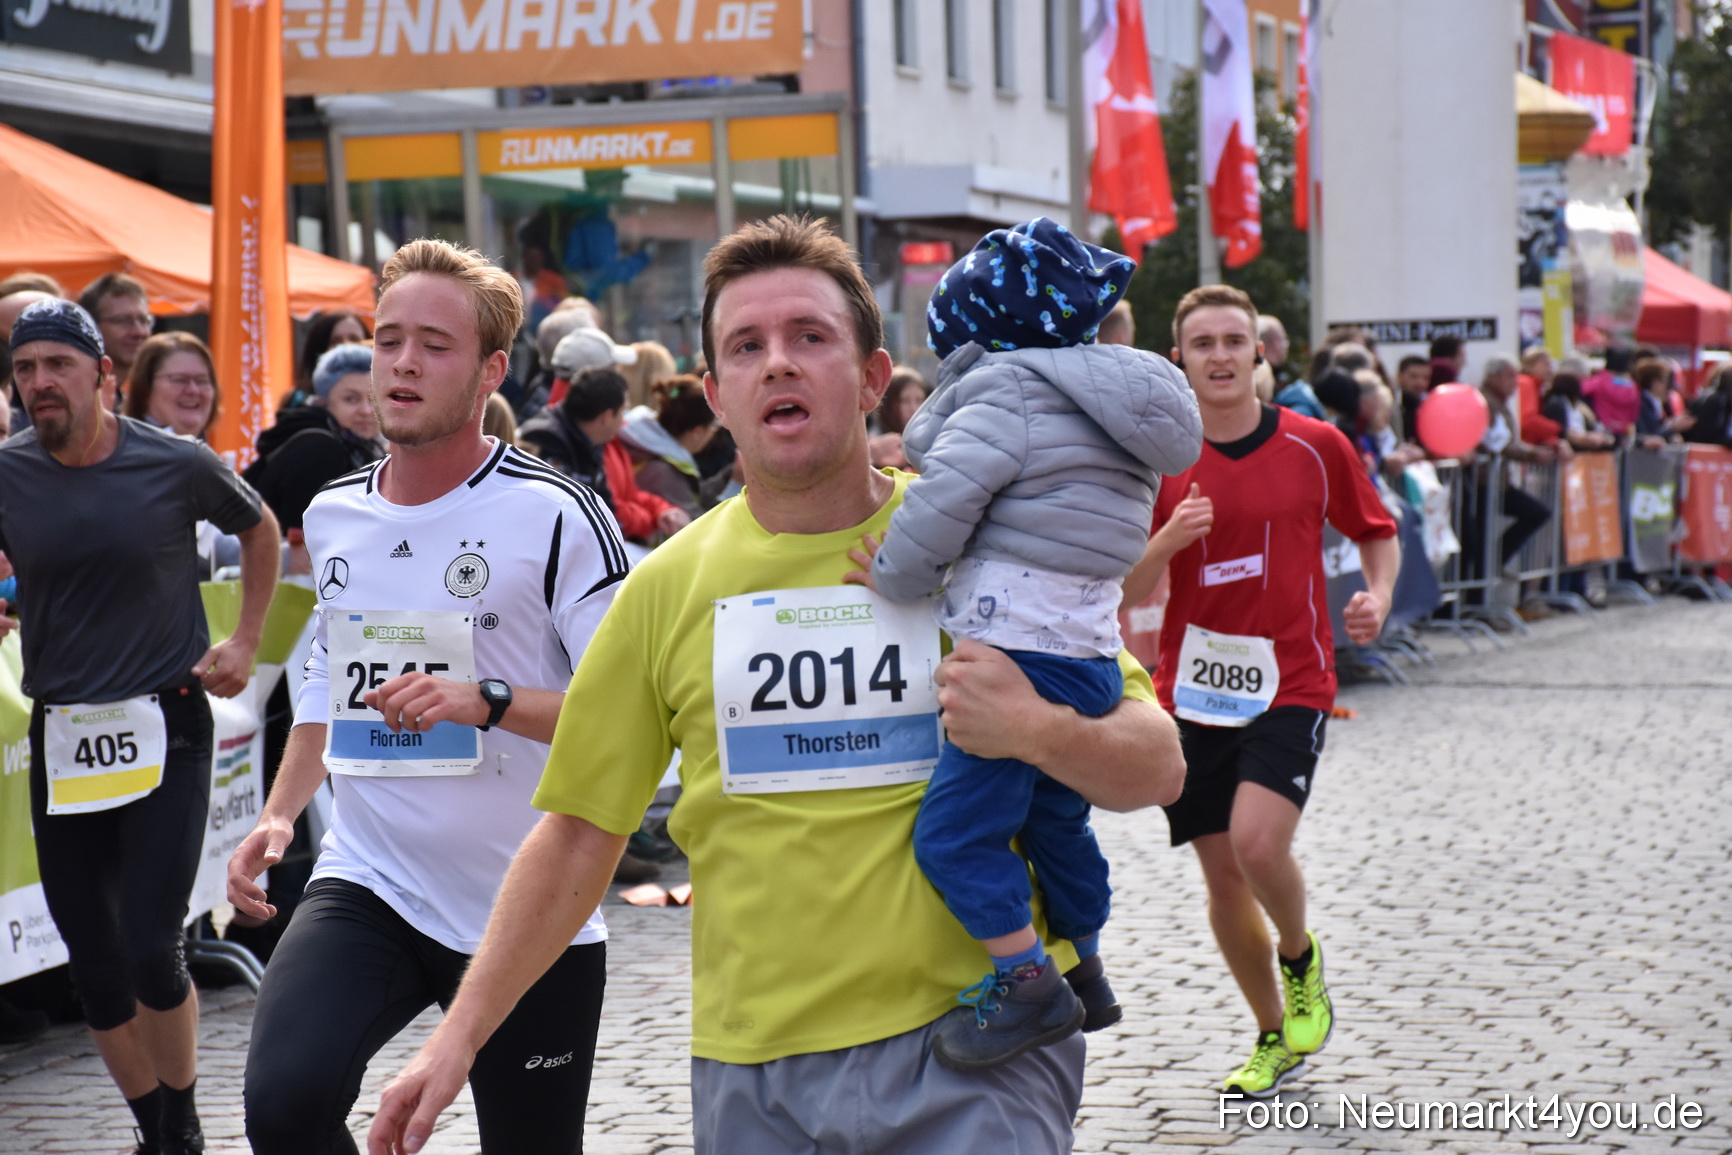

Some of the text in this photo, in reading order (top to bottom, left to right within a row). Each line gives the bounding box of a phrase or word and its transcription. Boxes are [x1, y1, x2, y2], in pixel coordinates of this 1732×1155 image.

[500, 131, 695, 166] RUNMARKT.DE
[1219, 563, 1247, 577] DEHN
[798, 604, 874, 623] BOCK
[376, 626, 426, 640] BOCK
[347, 661, 449, 710] 25
[748, 644, 908, 712] 2014
[1192, 658, 1263, 694] 2089
[729, 707, 737, 718] B
[1205, 697, 1239, 711] Patrick
[370, 729, 423, 747] Florian
[783, 731, 880, 755] Thorsten
[74, 731, 138, 769] 405
[543, 1051, 574, 1068] asics
